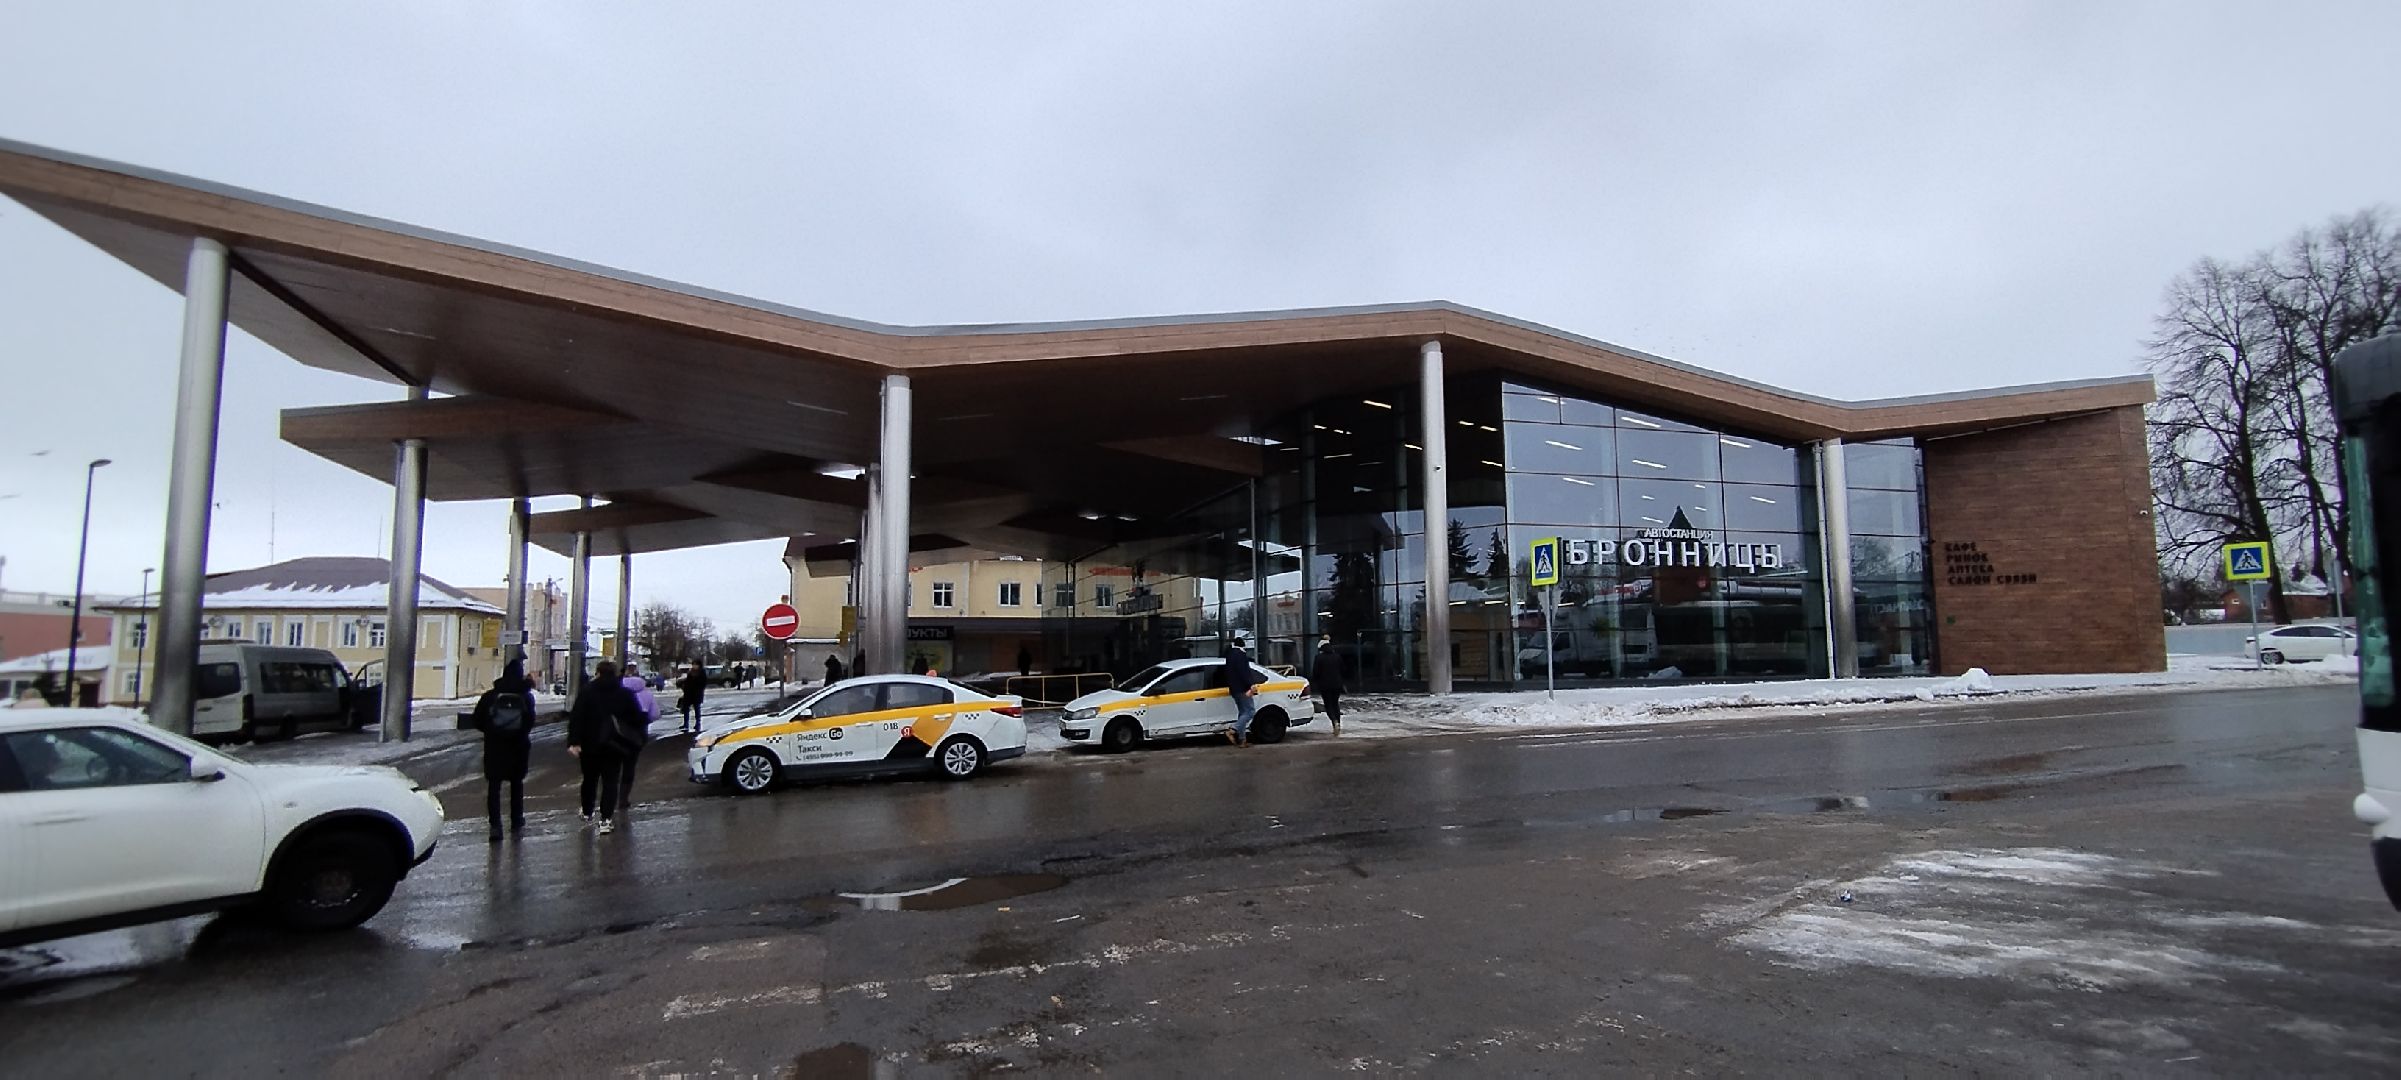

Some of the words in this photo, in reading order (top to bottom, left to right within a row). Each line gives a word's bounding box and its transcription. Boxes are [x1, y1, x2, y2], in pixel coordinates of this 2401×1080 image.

[1643, 527, 1713, 540] АВТОСТАНЦИЯ
[1945, 542, 1977, 552] КАФЕ
[1569, 539, 1784, 574] БРОННИЦЫ
[1947, 565, 1995, 574] АПТЕКА
[1947, 575, 1991, 585] САЛОН
[797, 732, 828, 742] Яндекс
[830, 729, 843, 739] Go
[798, 744, 823, 754] Такси
